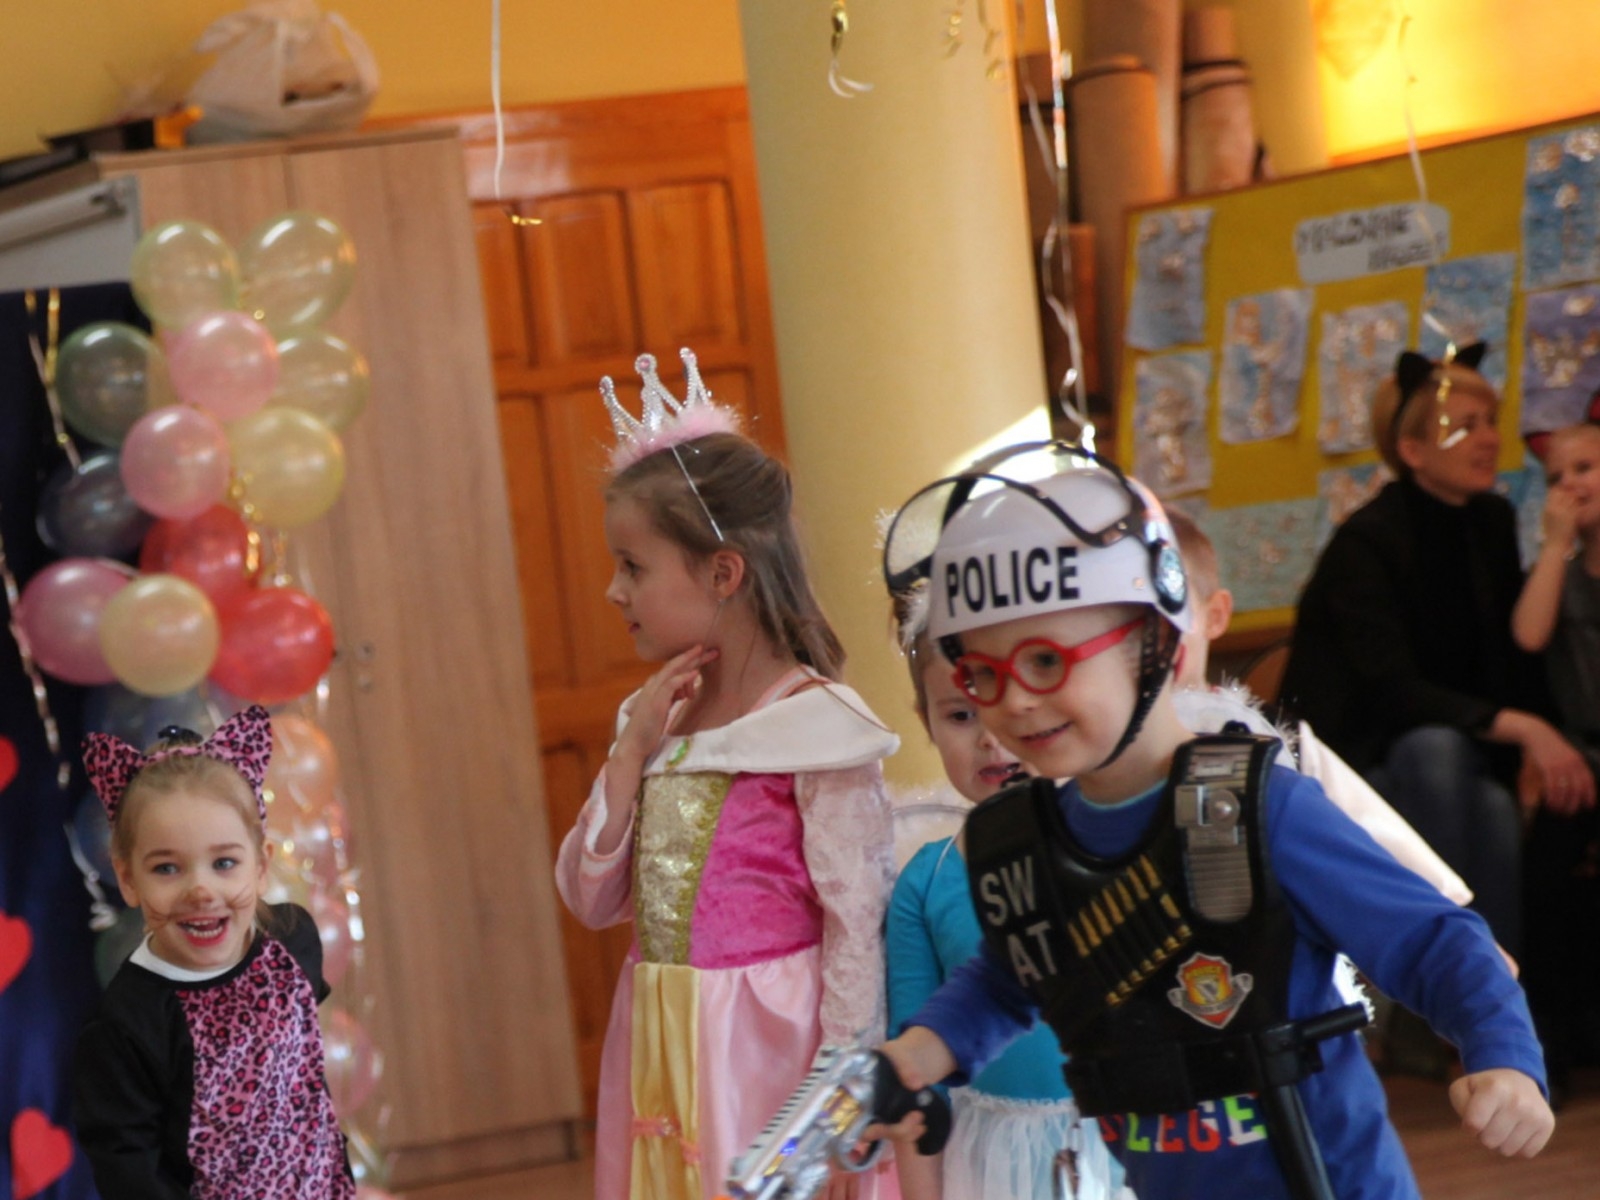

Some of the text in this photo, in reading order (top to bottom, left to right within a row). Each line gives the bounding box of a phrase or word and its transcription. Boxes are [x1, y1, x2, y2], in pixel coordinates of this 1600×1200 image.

[946, 547, 1079, 617] POLICE
[980, 856, 1035, 926] SW
[1007, 921, 1057, 987] AT
